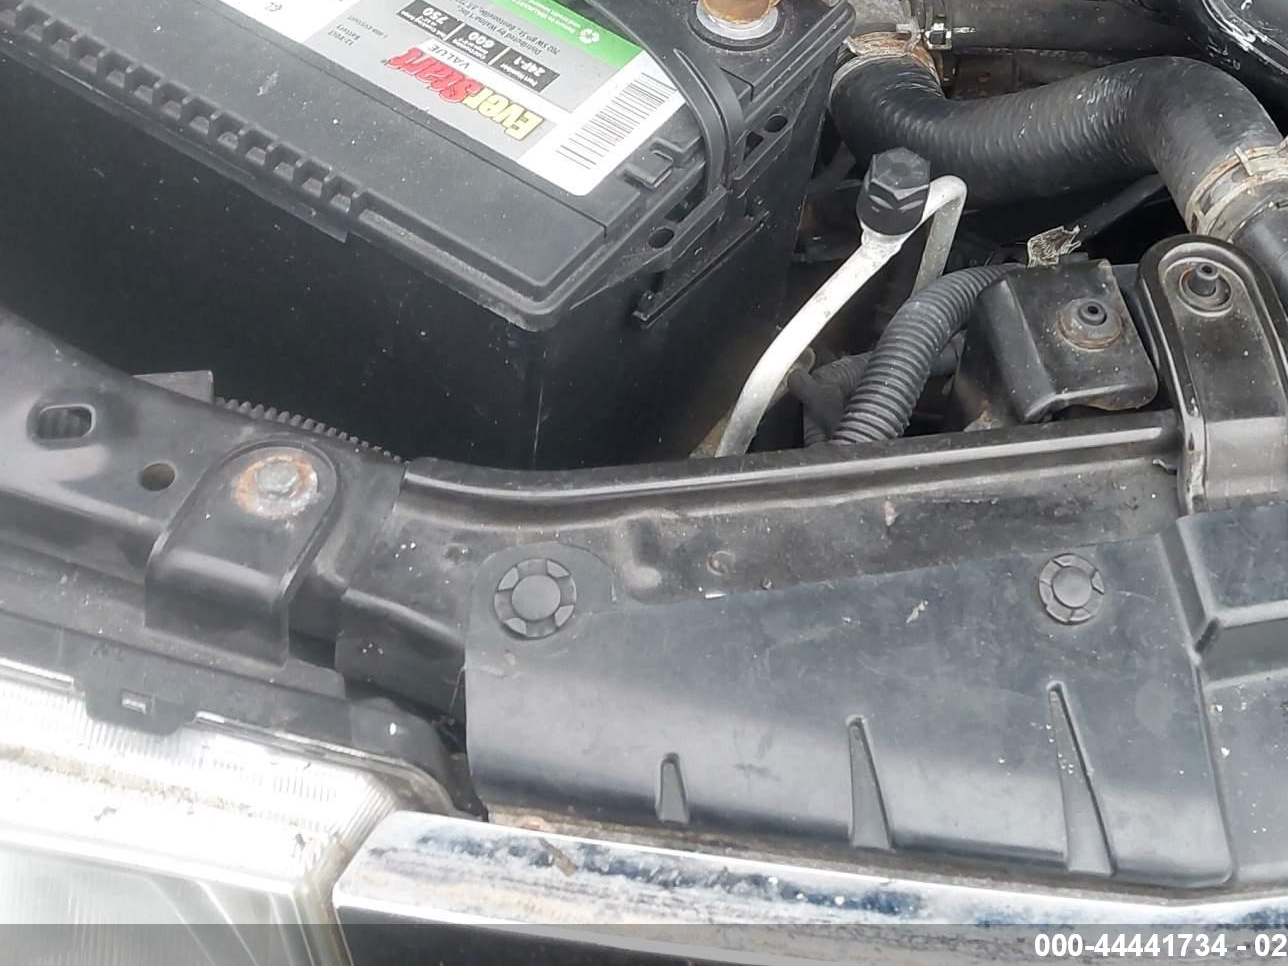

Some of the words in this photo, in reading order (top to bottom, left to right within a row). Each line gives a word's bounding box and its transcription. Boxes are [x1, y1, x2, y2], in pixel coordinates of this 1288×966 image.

[419, 5, 450, 25] 750
[467, 11, 499, 32] Walmart
[465, 29, 497, 50] 600
[502, 31, 542, 56] Distributed
[426, 42, 471, 70] VALUE
[510, 54, 547, 78] 24F-1
[381, 42, 545, 142] EverStart
